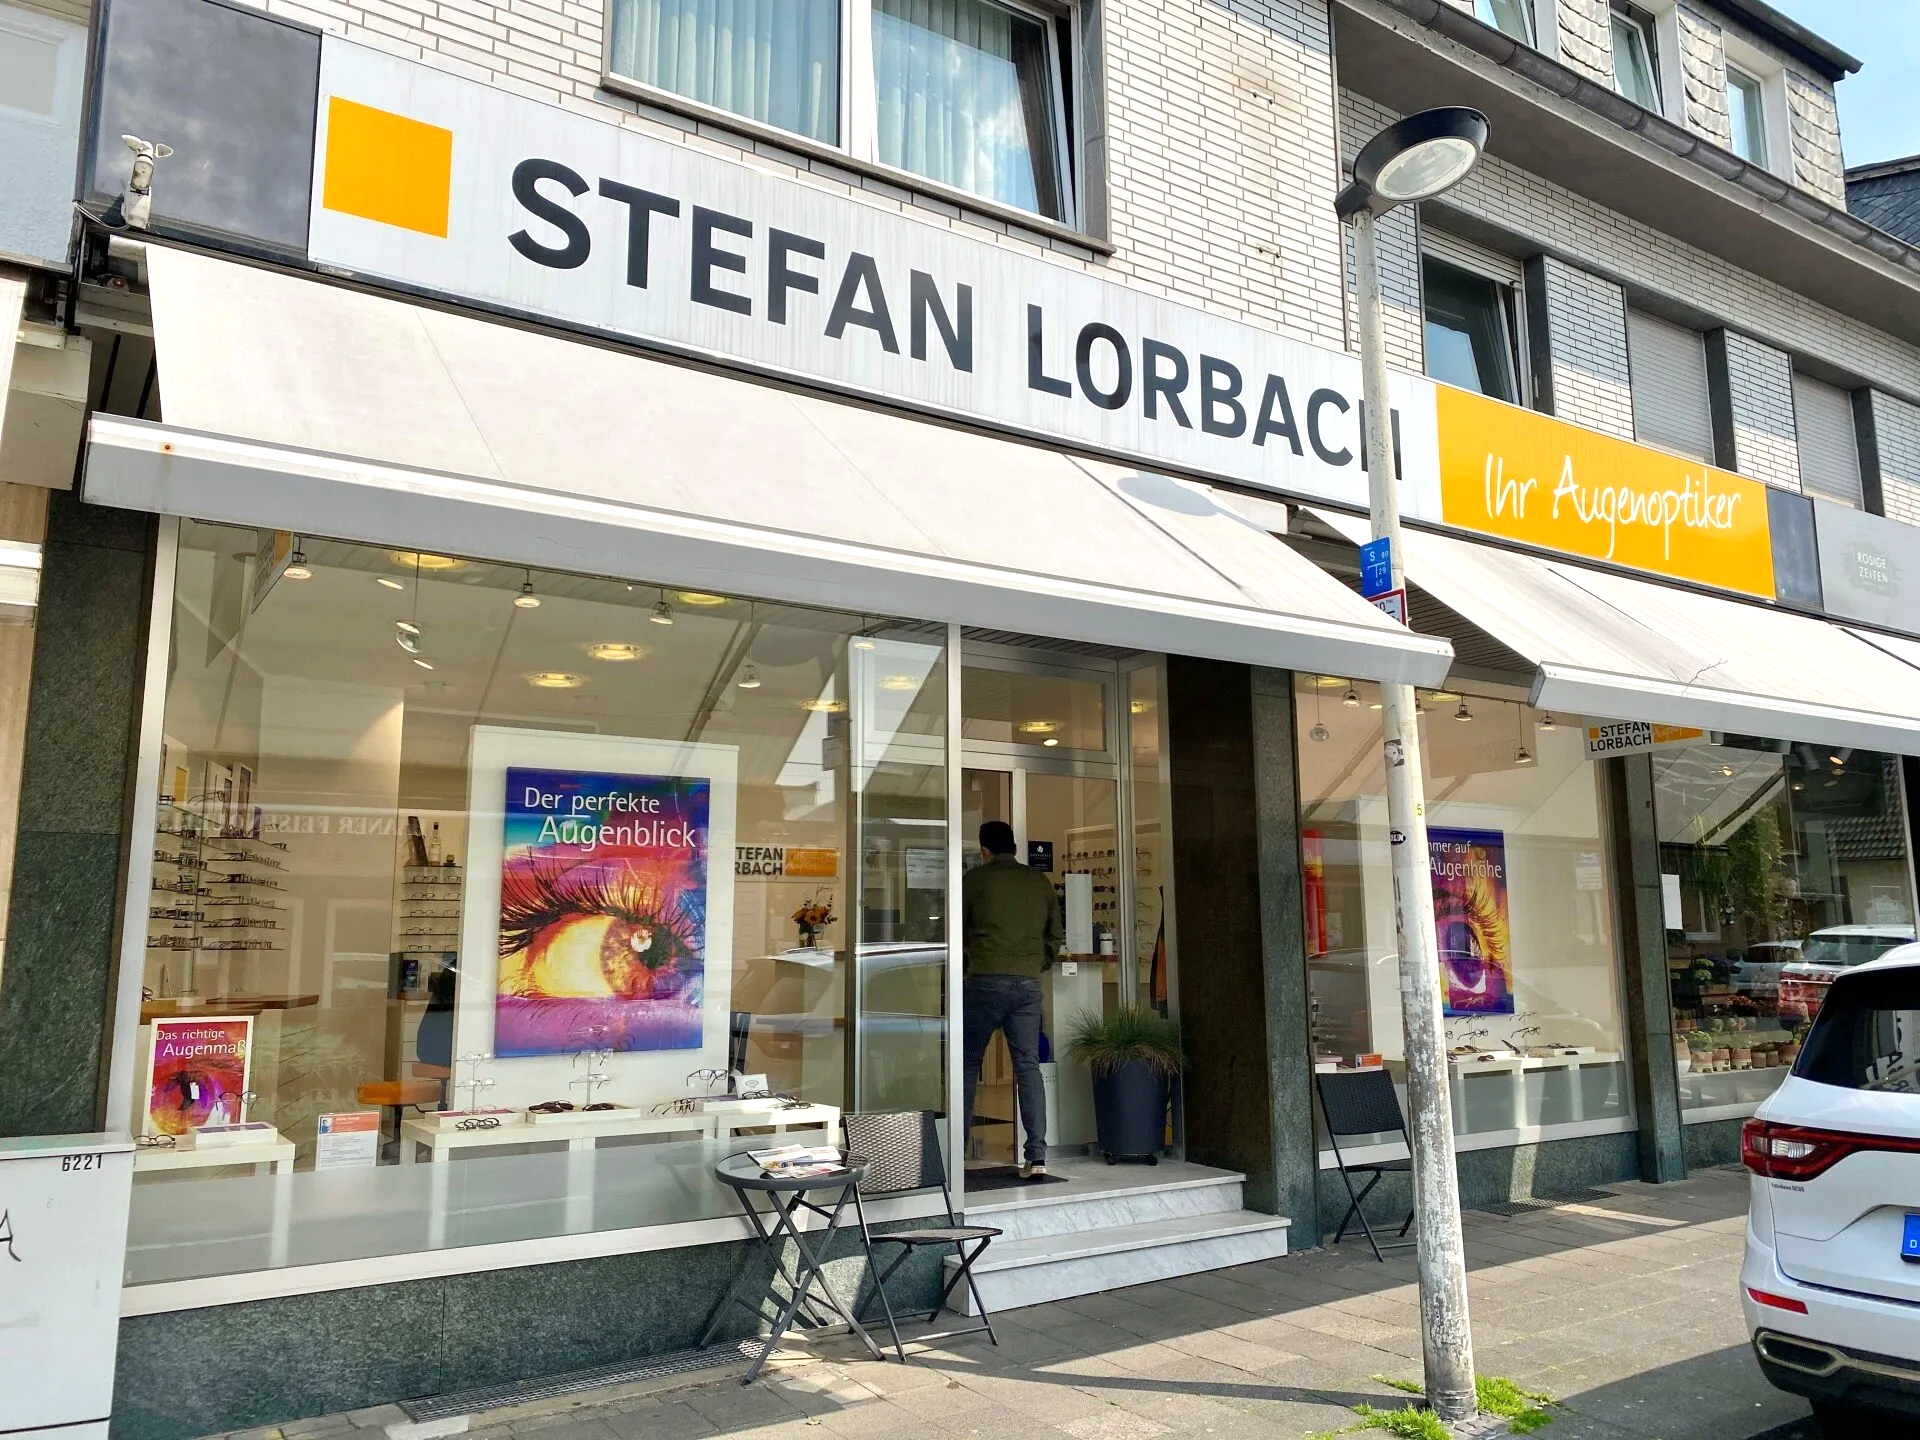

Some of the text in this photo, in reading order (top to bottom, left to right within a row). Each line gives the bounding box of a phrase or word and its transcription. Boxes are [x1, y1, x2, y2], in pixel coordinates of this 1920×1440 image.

[507, 158, 974, 374] STEFAN
[1485, 453, 1742, 561] Ihr Augenoptiker
[1857, 552, 1887, 569] ROSIGE
[1859, 566, 1888, 583] ZEITEN
[1600, 721, 1651, 738] STEFAN
[1590, 732, 1652, 752] LORBACH
[524, 786, 660, 816] Der perfekte
[537, 815, 697, 853] Augenblick
[736, 846, 783, 860] TEFAN
[1428, 840, 1472, 854] mmer auf
[735, 861, 783, 876] RBACH
[1430, 857, 1502, 881] Augenhöhe
[156, 1028, 225, 1040] Das richtige
[162, 1040, 246, 1059] Augenmaß
[61, 1154, 103, 1172] 6221
[1909, 1239, 1918, 1249] D
